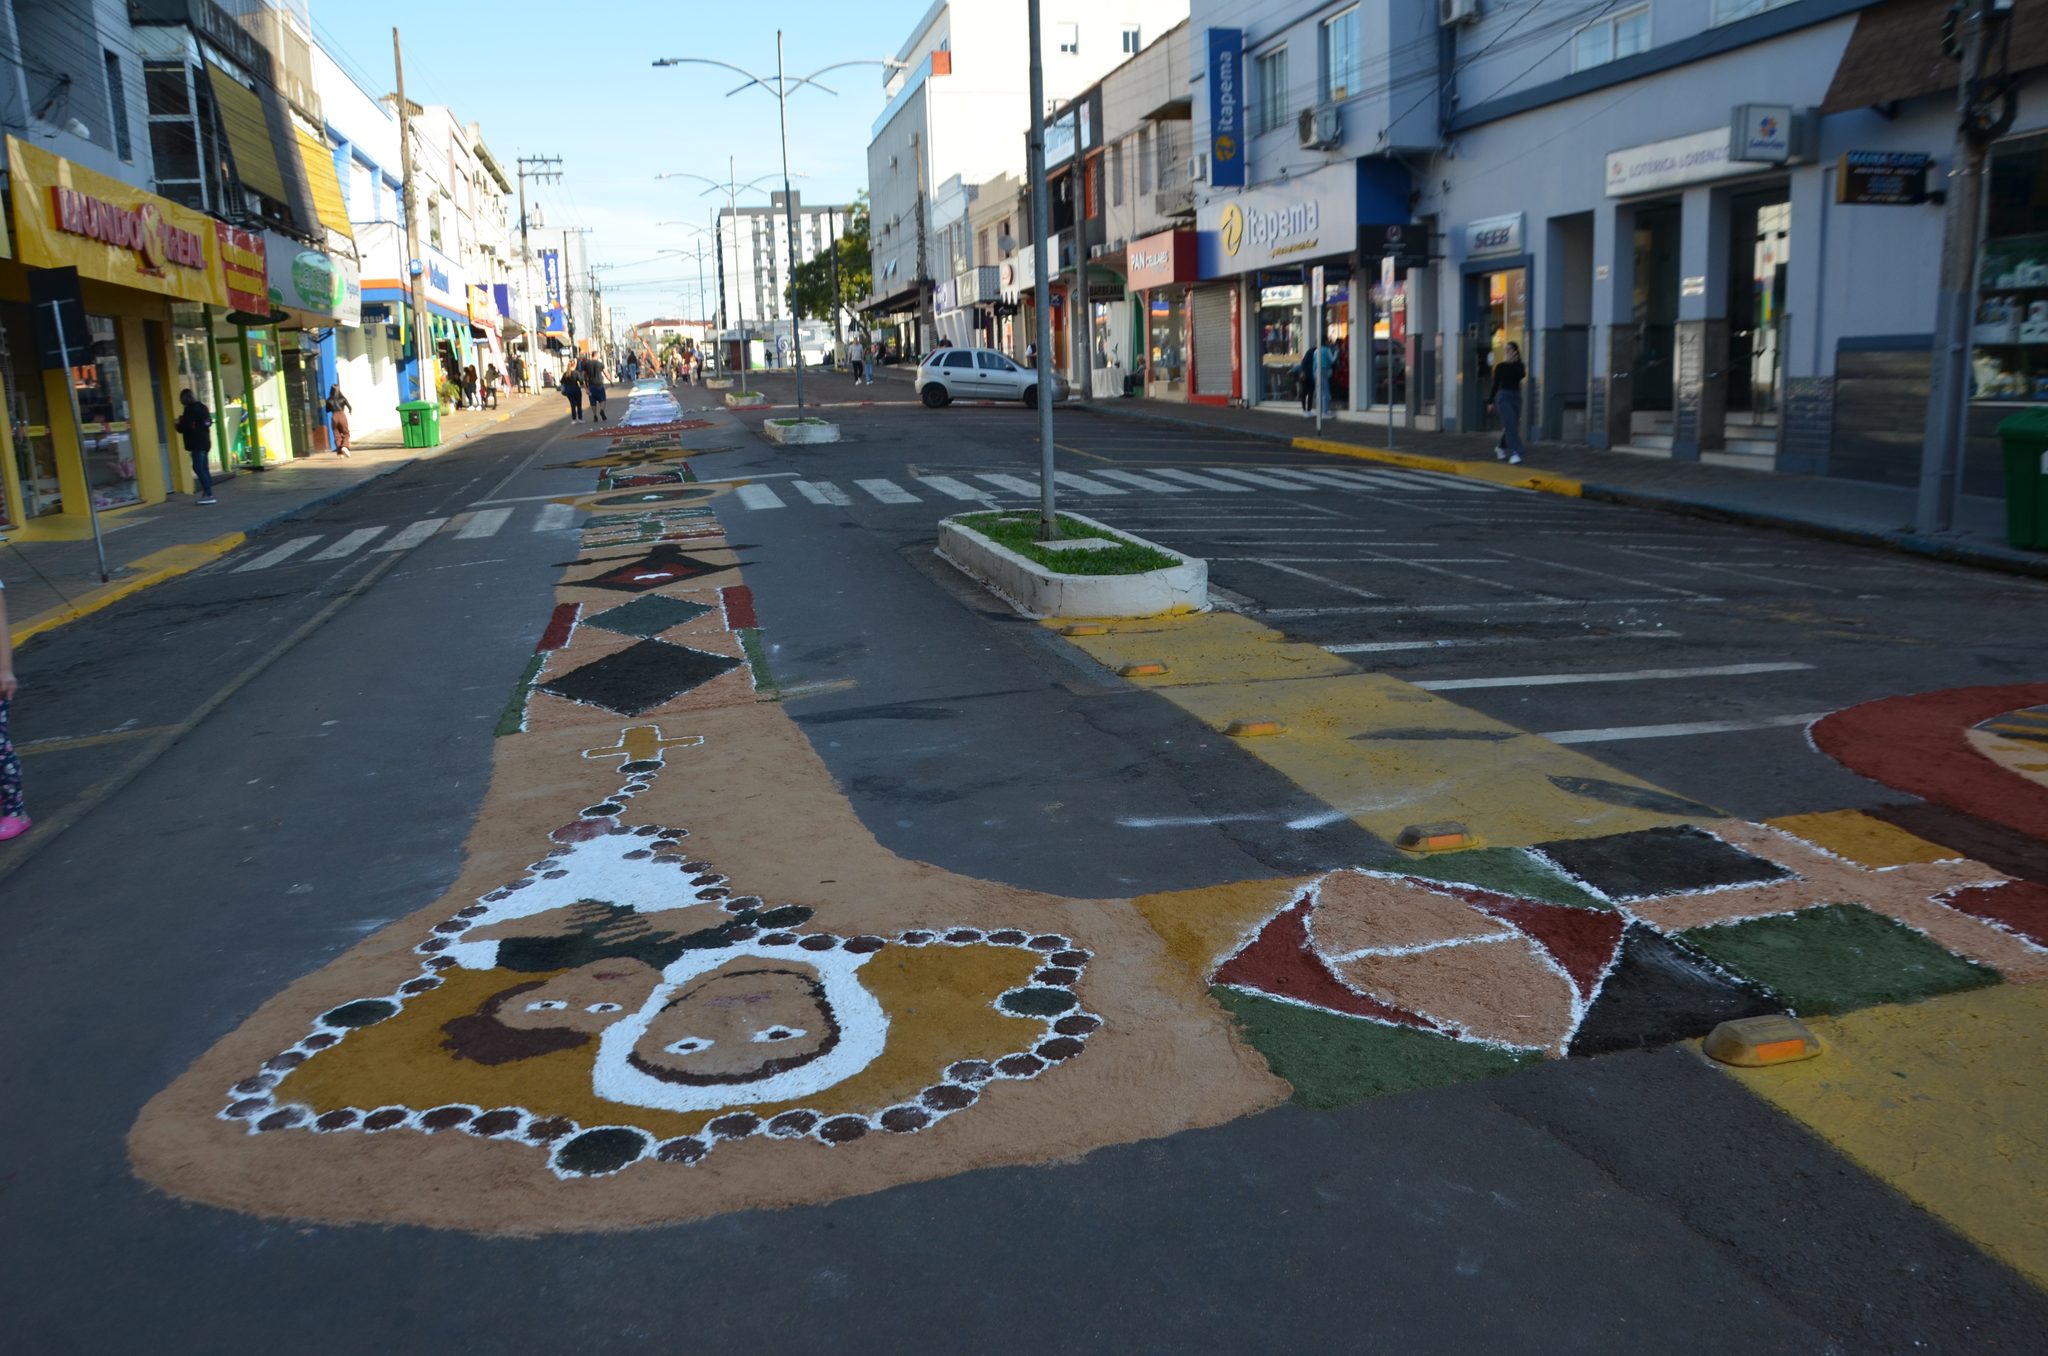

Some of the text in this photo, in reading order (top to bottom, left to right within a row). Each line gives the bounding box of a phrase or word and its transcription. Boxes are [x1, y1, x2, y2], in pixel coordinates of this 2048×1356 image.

[1219, 50, 1237, 132] itapema
[52, 185, 145, 251] MUNDO
[163, 222, 207, 270] REAL
[1247, 199, 1320, 249] itapema
[1130, 251, 1146, 271] PAN
